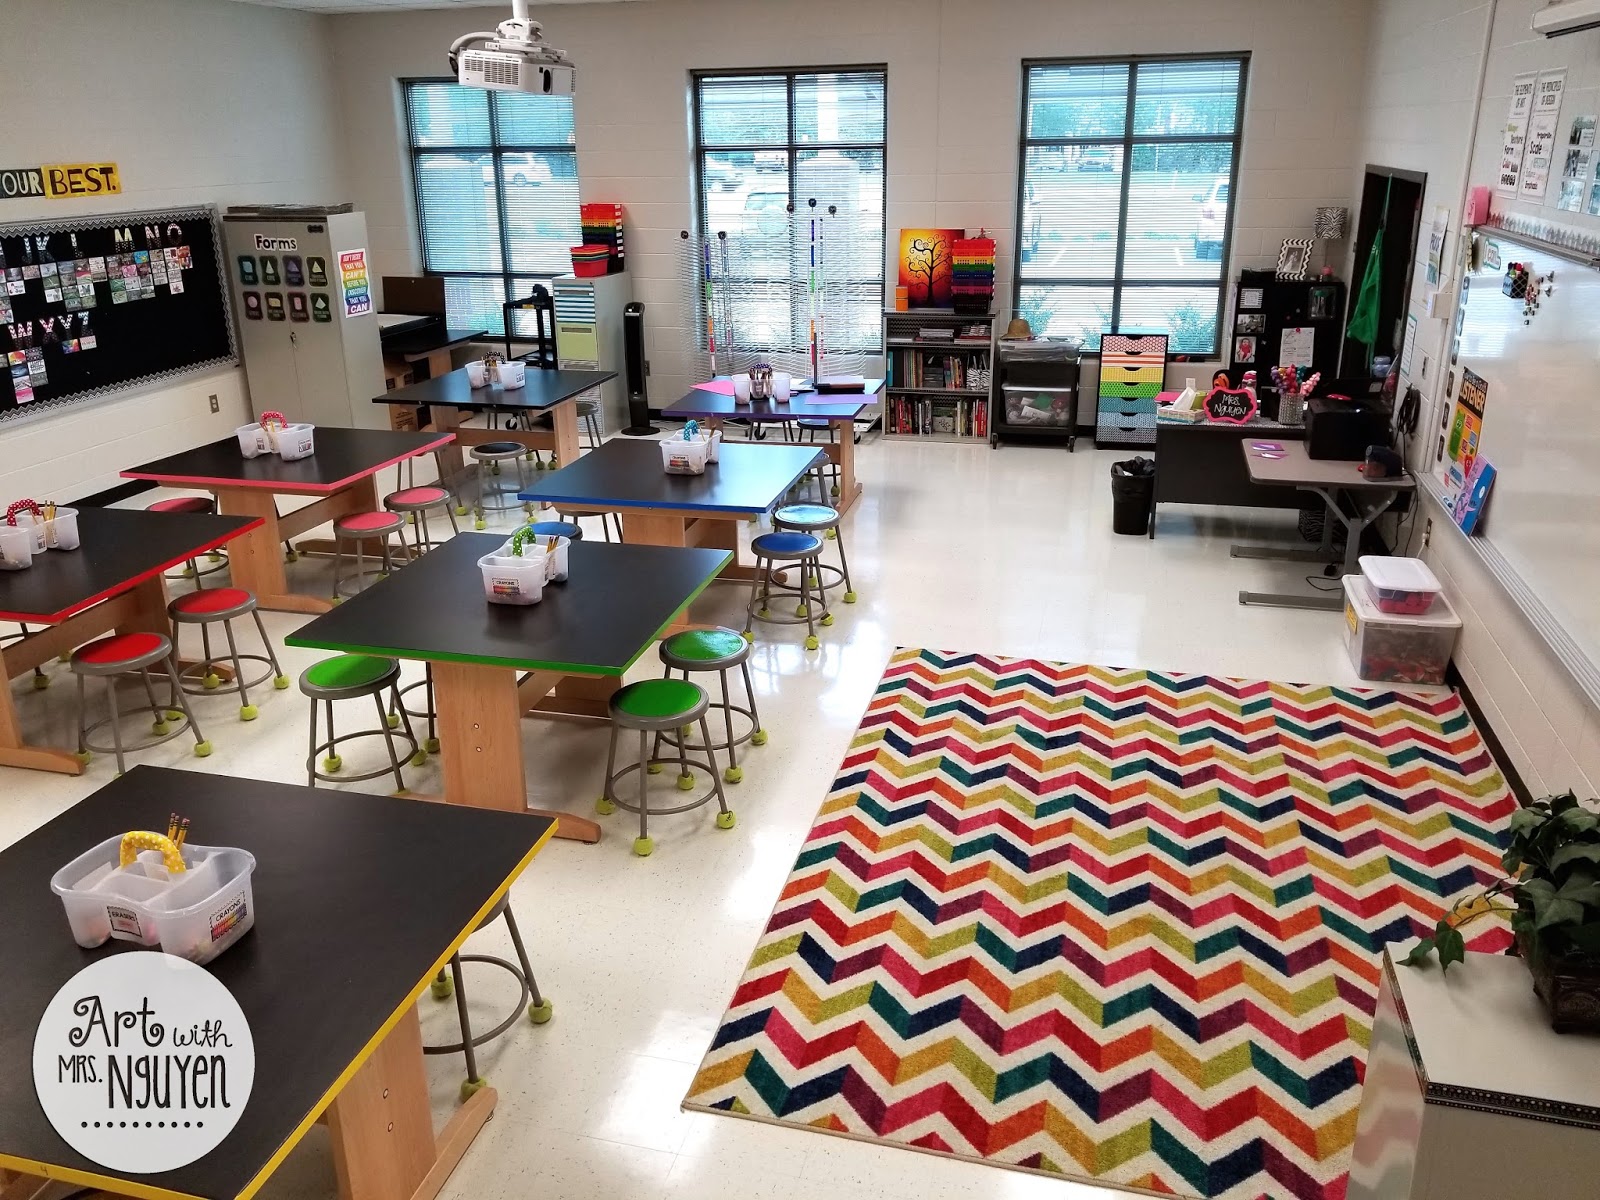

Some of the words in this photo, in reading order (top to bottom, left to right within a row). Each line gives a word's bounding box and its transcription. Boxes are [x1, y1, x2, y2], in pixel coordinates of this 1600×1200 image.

[0, 171, 43, 195] OUR
[49, 167, 117, 195] BEST.
[114, 228, 135, 253] M
[145, 225, 162, 249] N
[255, 234, 297, 250] Forms
[346, 270, 363, 279] CAN'T
[350, 304, 368, 313] CAN
[1460, 380, 1486, 413] LISTENER
[111, 911, 136, 922] ERASERS
[216, 898, 241, 922] CRAYONS
[40, 1165, 49, 1176] 4
